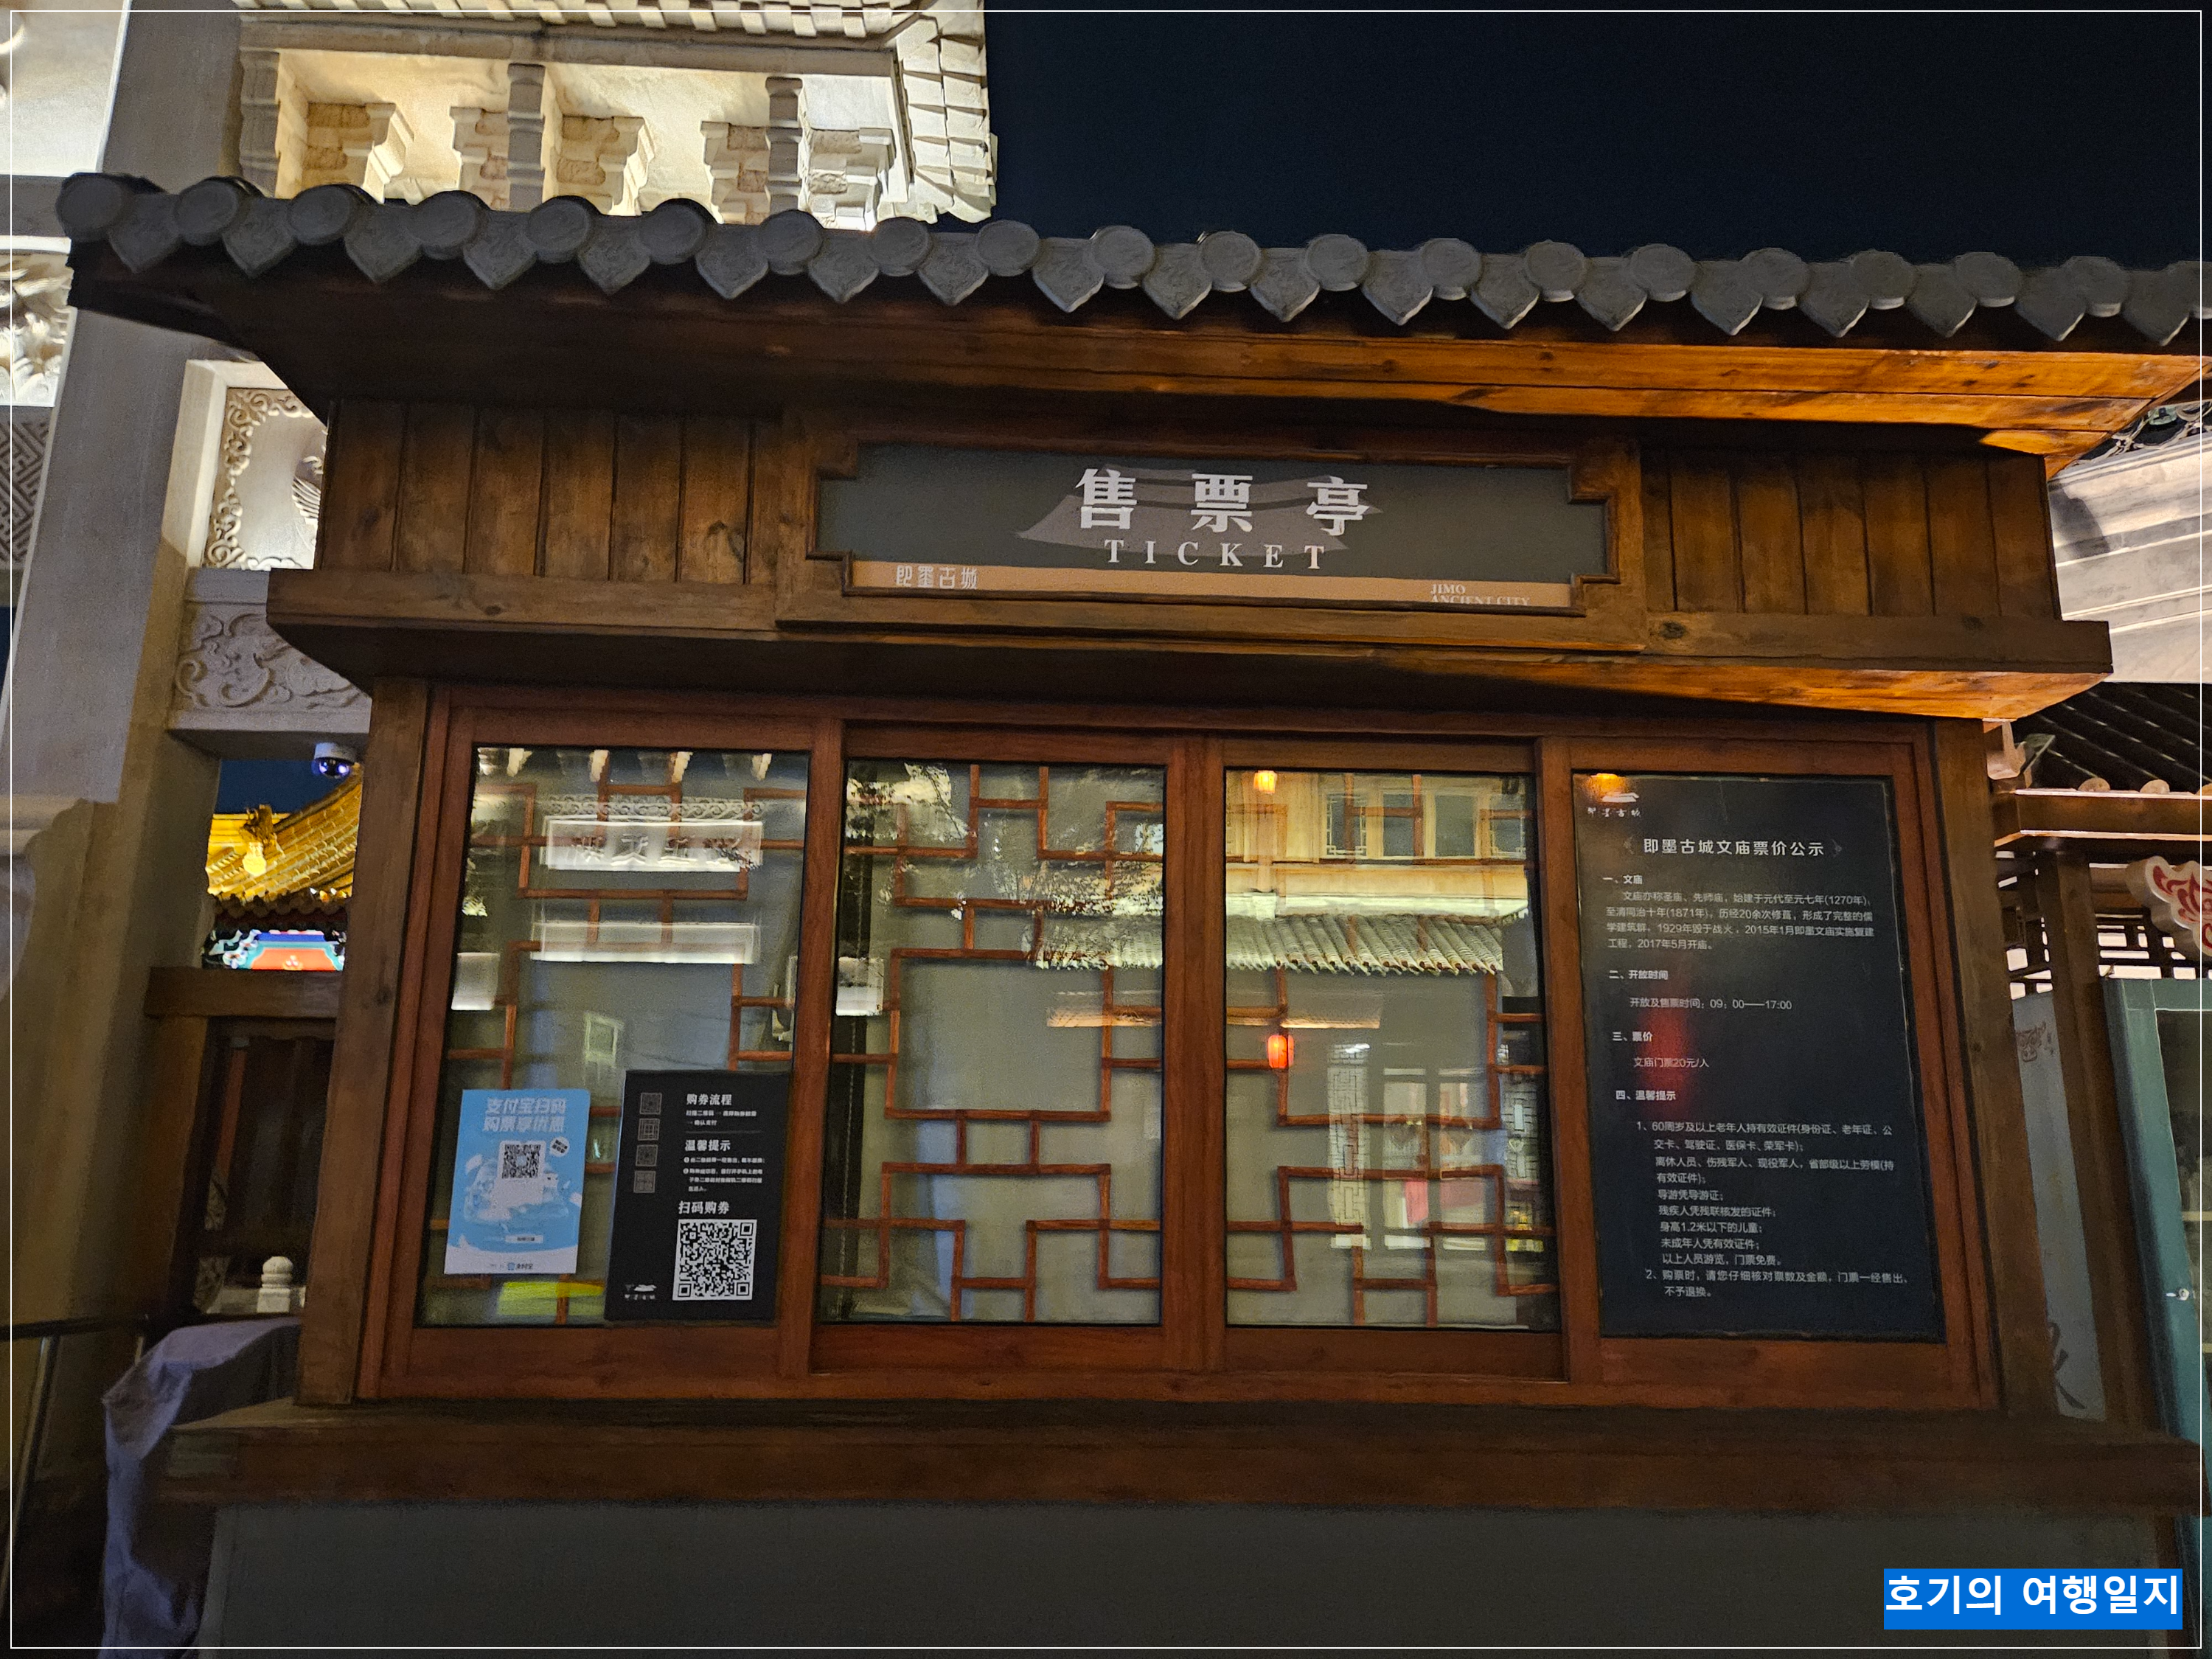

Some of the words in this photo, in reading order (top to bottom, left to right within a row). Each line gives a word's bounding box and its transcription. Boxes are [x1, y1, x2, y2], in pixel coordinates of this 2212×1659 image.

[1075, 468, 1369, 536] 售票亭
[1105, 539, 1324, 569] TICKET
[896, 565, 978, 589] 即墨古城
[1430, 583, 1466, 594] JIMO
[1431, 595, 1493, 605] ANCIENT
[1497, 597, 1531, 606] CITY
[1644, 838, 1825, 857] 即墨古城文庙票价公示
[1602, 874, 1643, 885] 一、文庙
[1609, 970, 1669, 980] 二、开放时间
[1613, 1032, 1653, 1042] 三、票价
[686, 1093, 732, 1105] 购券流程
[1615, 1090, 1676, 1101] 四、温馨提示
[685, 1139, 731, 1151] 温馨提示
[678, 1200, 730, 1214] 扫码购券
